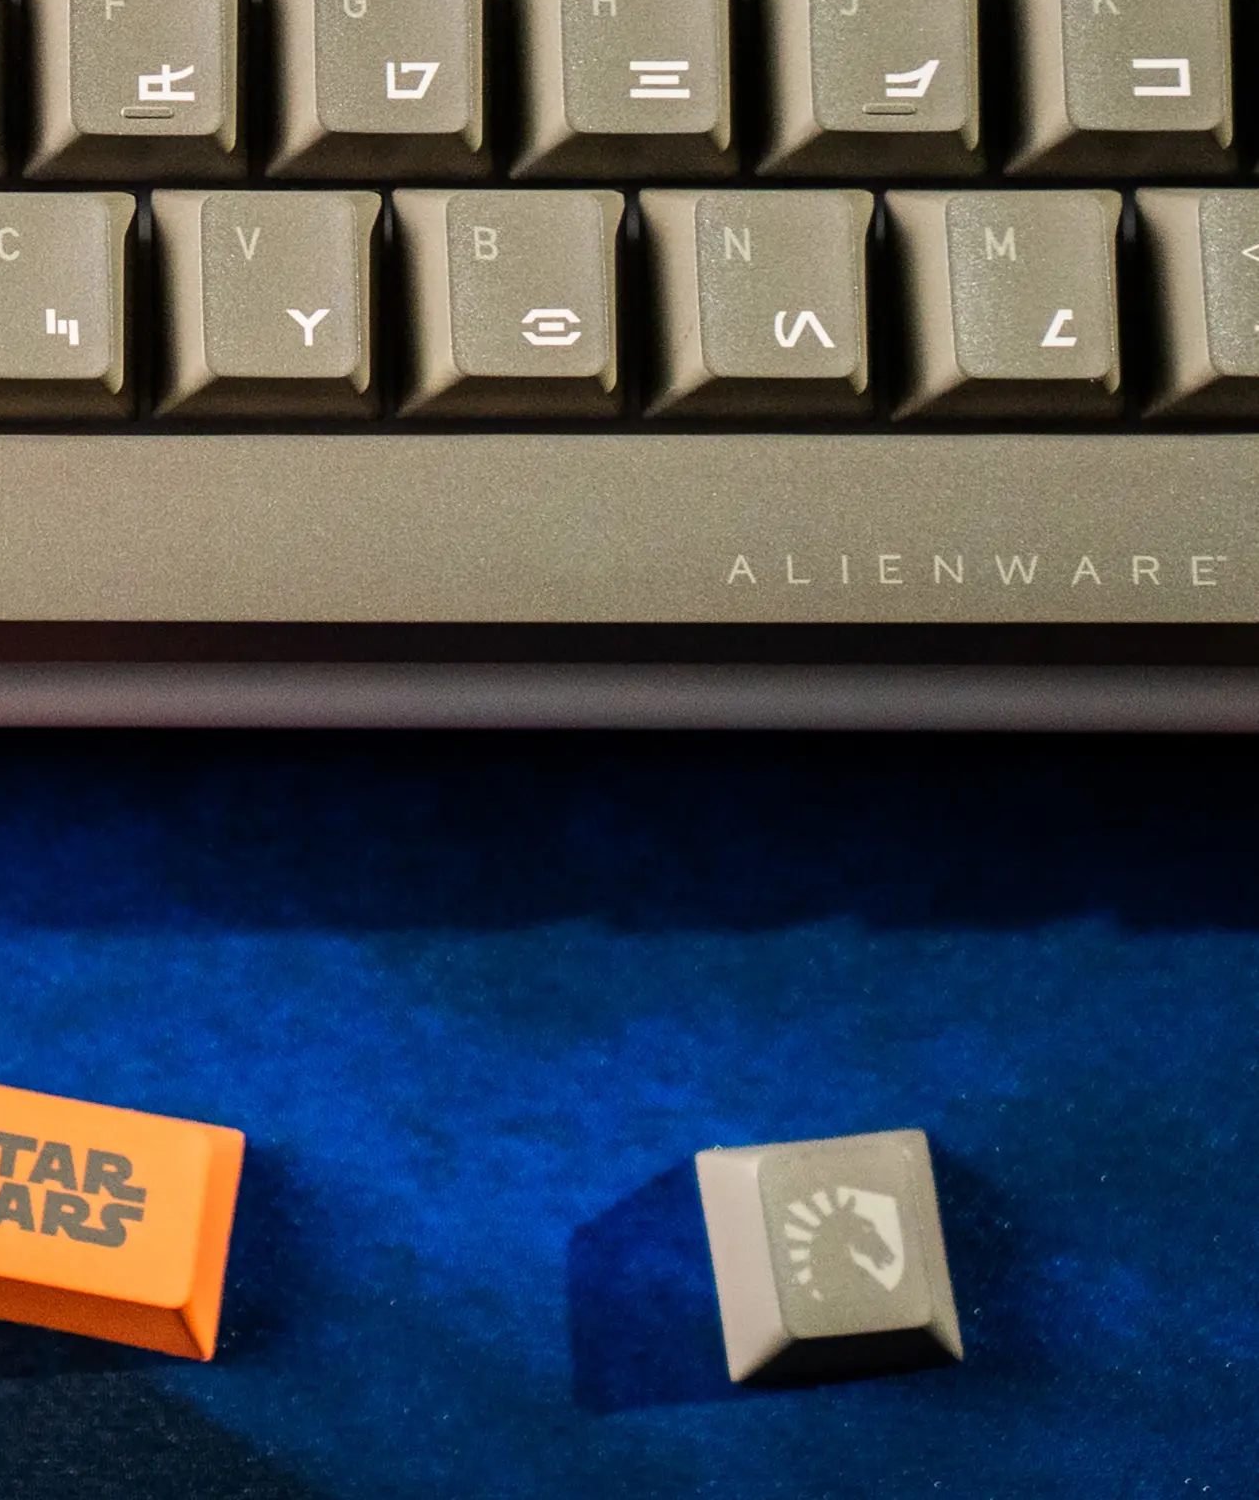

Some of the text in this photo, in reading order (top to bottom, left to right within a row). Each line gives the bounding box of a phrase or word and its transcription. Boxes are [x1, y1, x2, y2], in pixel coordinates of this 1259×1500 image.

[235, 226, 261, 261] V
[473, 225, 499, 261] B
[723, 226, 751, 262] N
[984, 227, 1017, 261] M
[727, 553, 1218, 587] ALIENWARE
